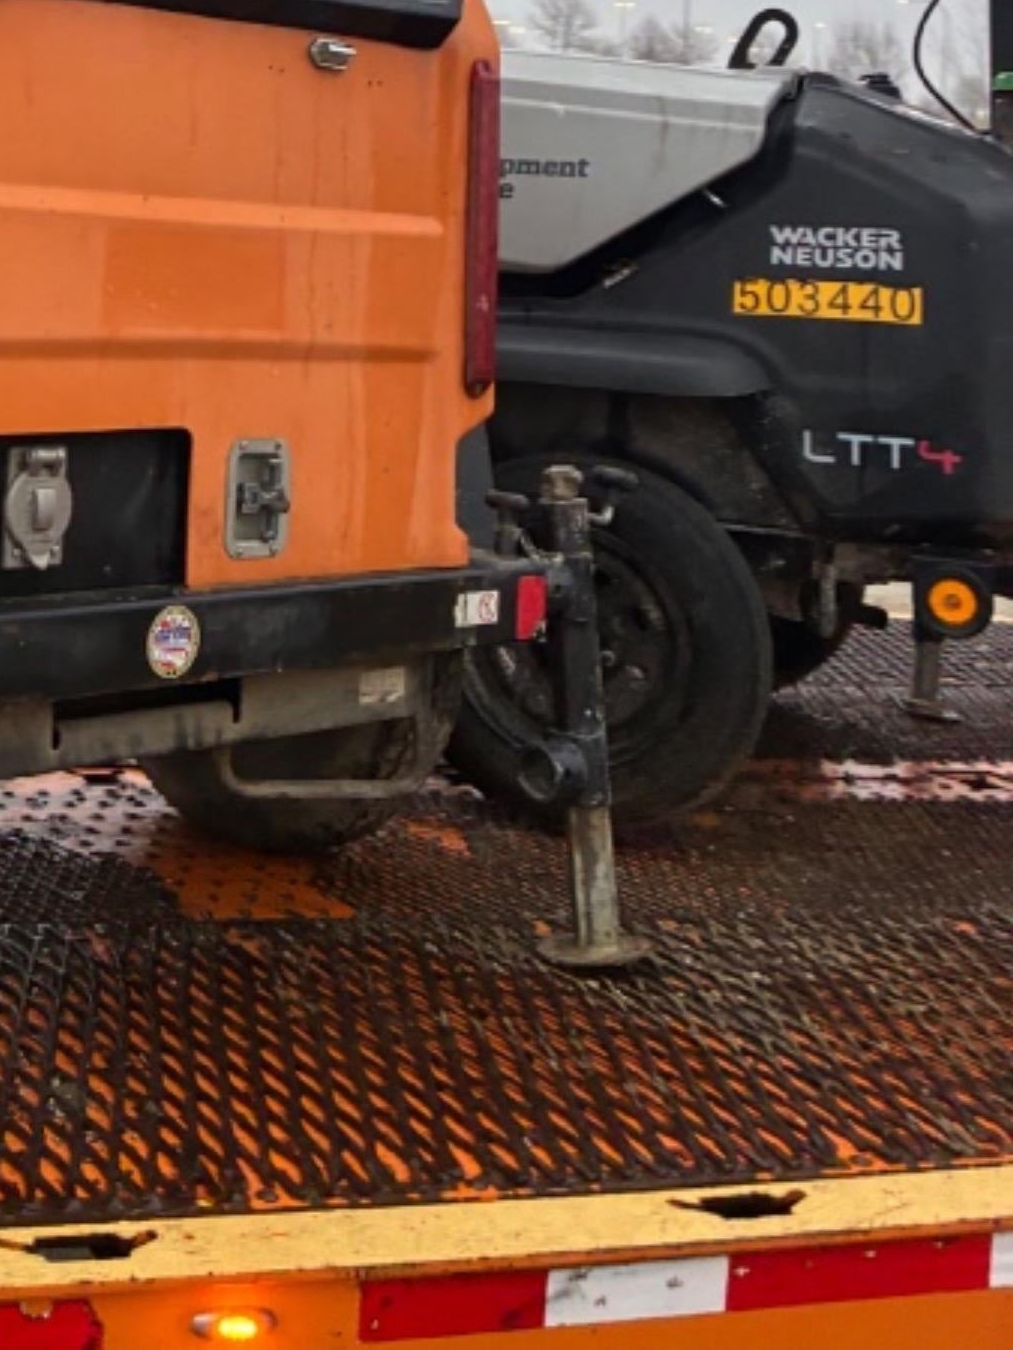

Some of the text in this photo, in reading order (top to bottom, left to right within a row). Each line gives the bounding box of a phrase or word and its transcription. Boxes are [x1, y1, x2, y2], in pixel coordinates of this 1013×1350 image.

[769, 225, 903, 250] WACKER
[769, 246, 904, 271] NEUSON
[738, 279, 917, 322] 503440
[802, 430, 963, 475] LTT4
